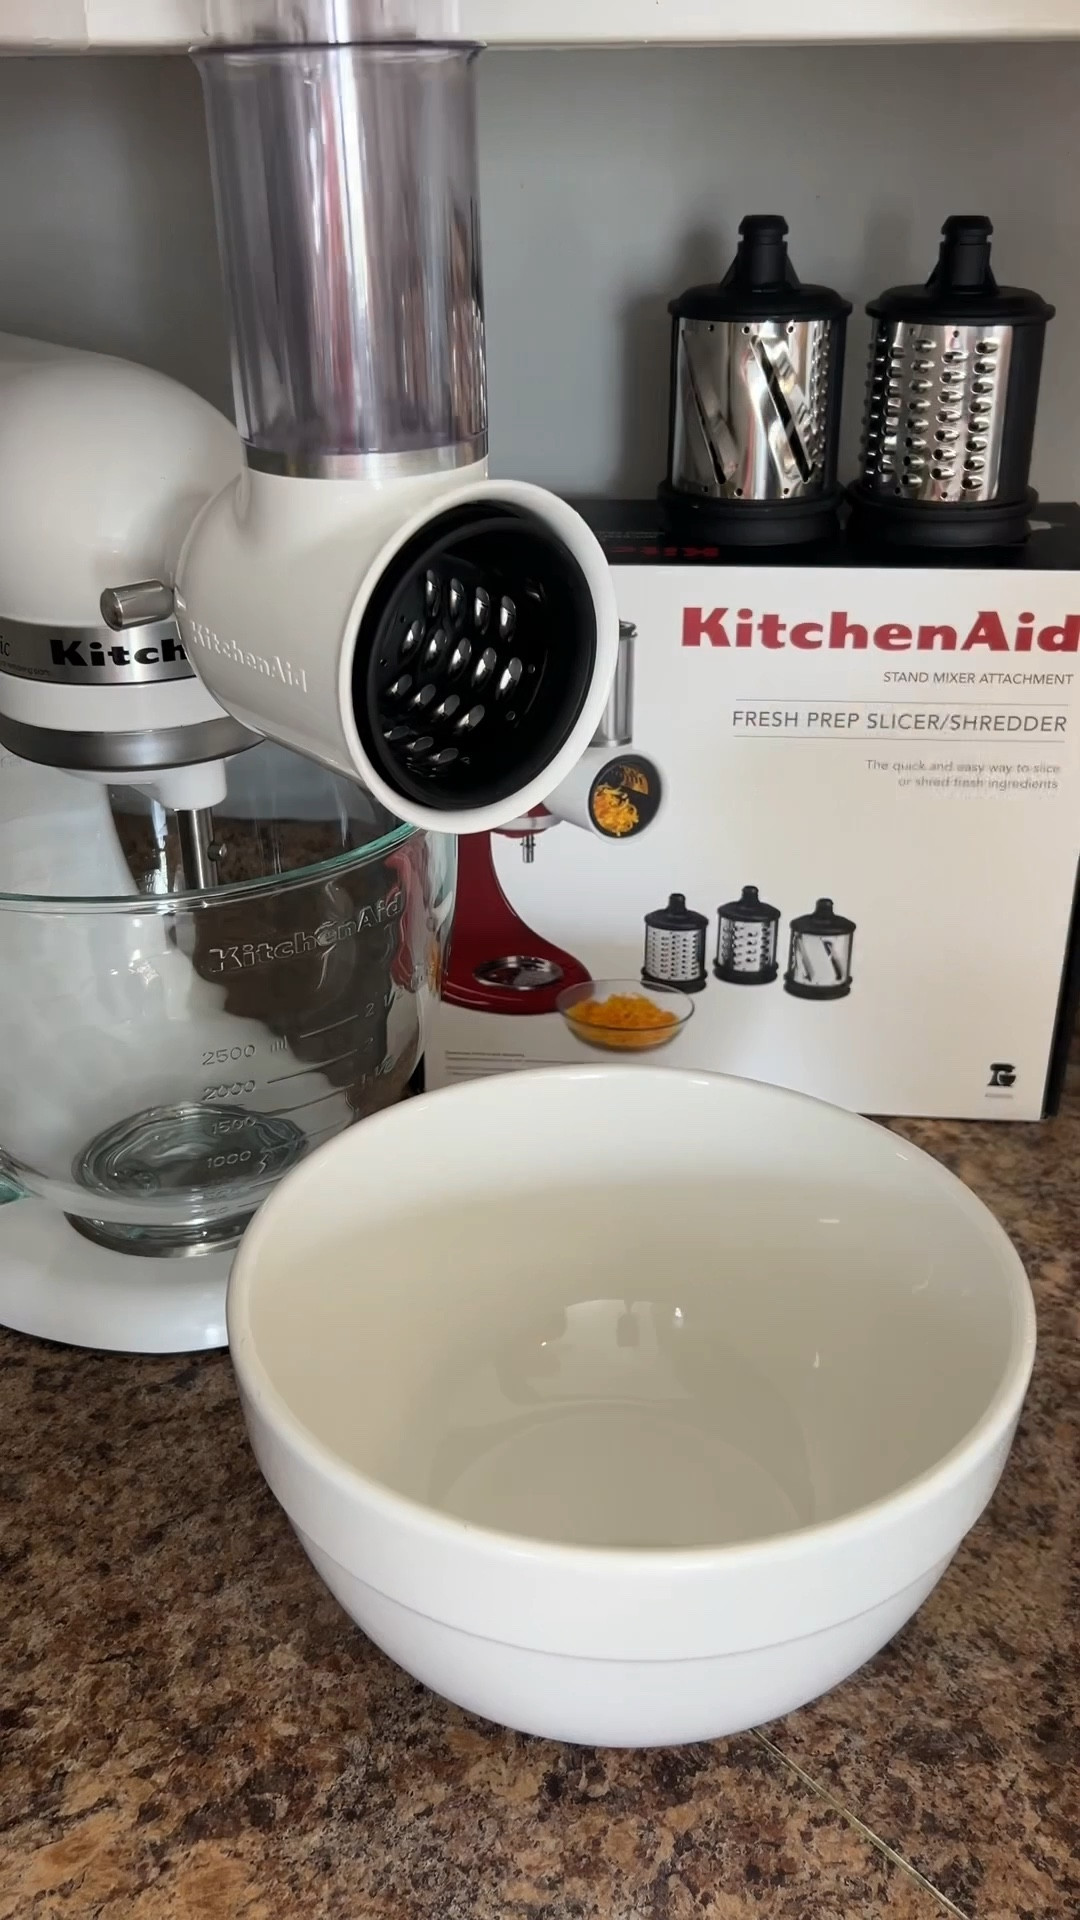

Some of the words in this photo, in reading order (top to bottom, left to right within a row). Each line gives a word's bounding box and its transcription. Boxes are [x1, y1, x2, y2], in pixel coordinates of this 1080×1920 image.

[681, 606, 1080, 653] KitchenAid
[191, 621, 308, 693] KitchenAid
[883, 671, 929, 684] STAND
[933, 672, 975, 685] MIXER
[979, 672, 1074, 686] ATTACHMENT
[732, 711, 798, 728] FRESH
[807, 712, 860, 729] PREP
[867, 713, 1068, 733] SLICER/SHREDDER
[866, 759, 889, 771] The
[892, 760, 925, 773] quick
[931, 761, 953, 771] and
[957, 763, 985, 774] easy
[989, 764, 1013, 775] way
[1017, 763, 1030, 773] to
[1033, 762, 1061, 774] slice
[898, 778, 910, 787] or
[915, 776, 950, 788] shred
[988, 778, 1059, 791] ingredients
[208, 891, 402, 973] KitchenAid
[365, 1002, 375, 1018] 2
[202, 1044, 256, 1066] 2500
[202, 1079, 257, 1101] 2000
[211, 1116, 257, 1135] 1500
[207, 1150, 252, 1169] 1000
